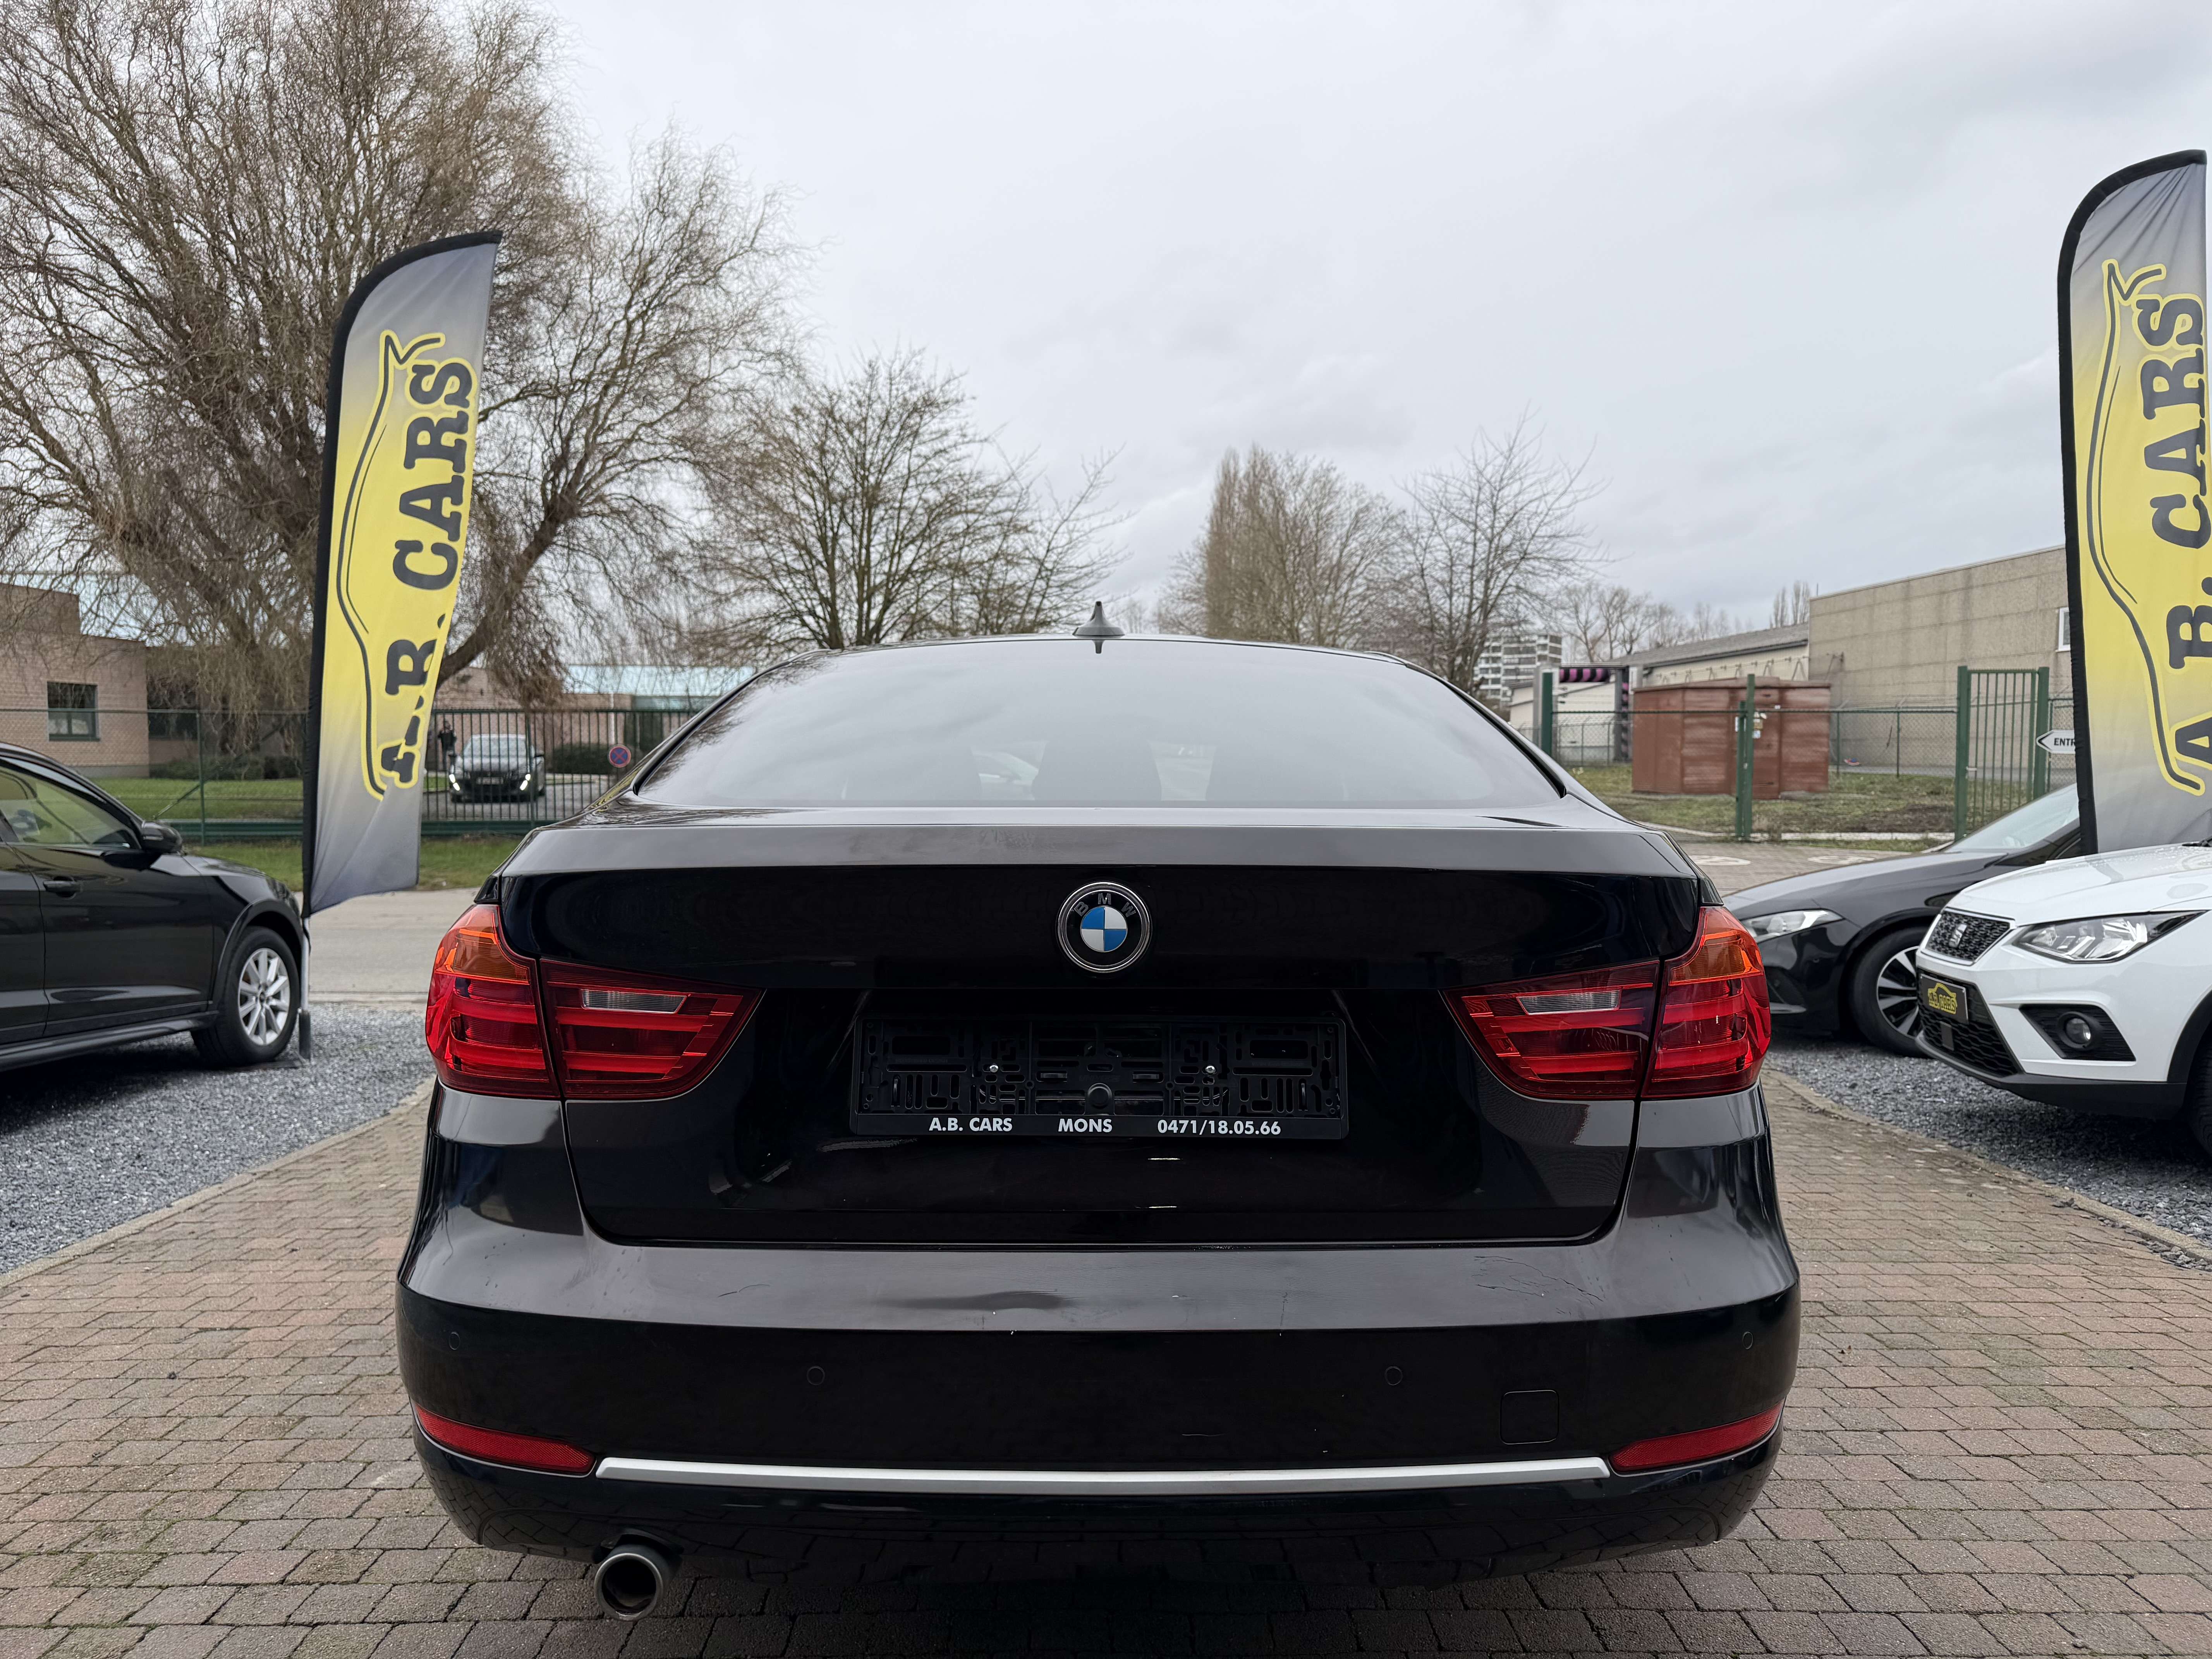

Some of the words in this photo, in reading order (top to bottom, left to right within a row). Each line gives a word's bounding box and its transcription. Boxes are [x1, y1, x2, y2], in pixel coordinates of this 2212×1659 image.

[392, 362, 472, 591] CARS
[2136, 298, 2211, 549] CARS
[1073, 893, 1136, 917] BMW
[929, 1118, 963, 1131] A.B.
[969, 1118, 1013, 1132] CARS
[1058, 1118, 1113, 1132] MONS
[1158, 1120, 1281, 1135] 0471/18.05.66
